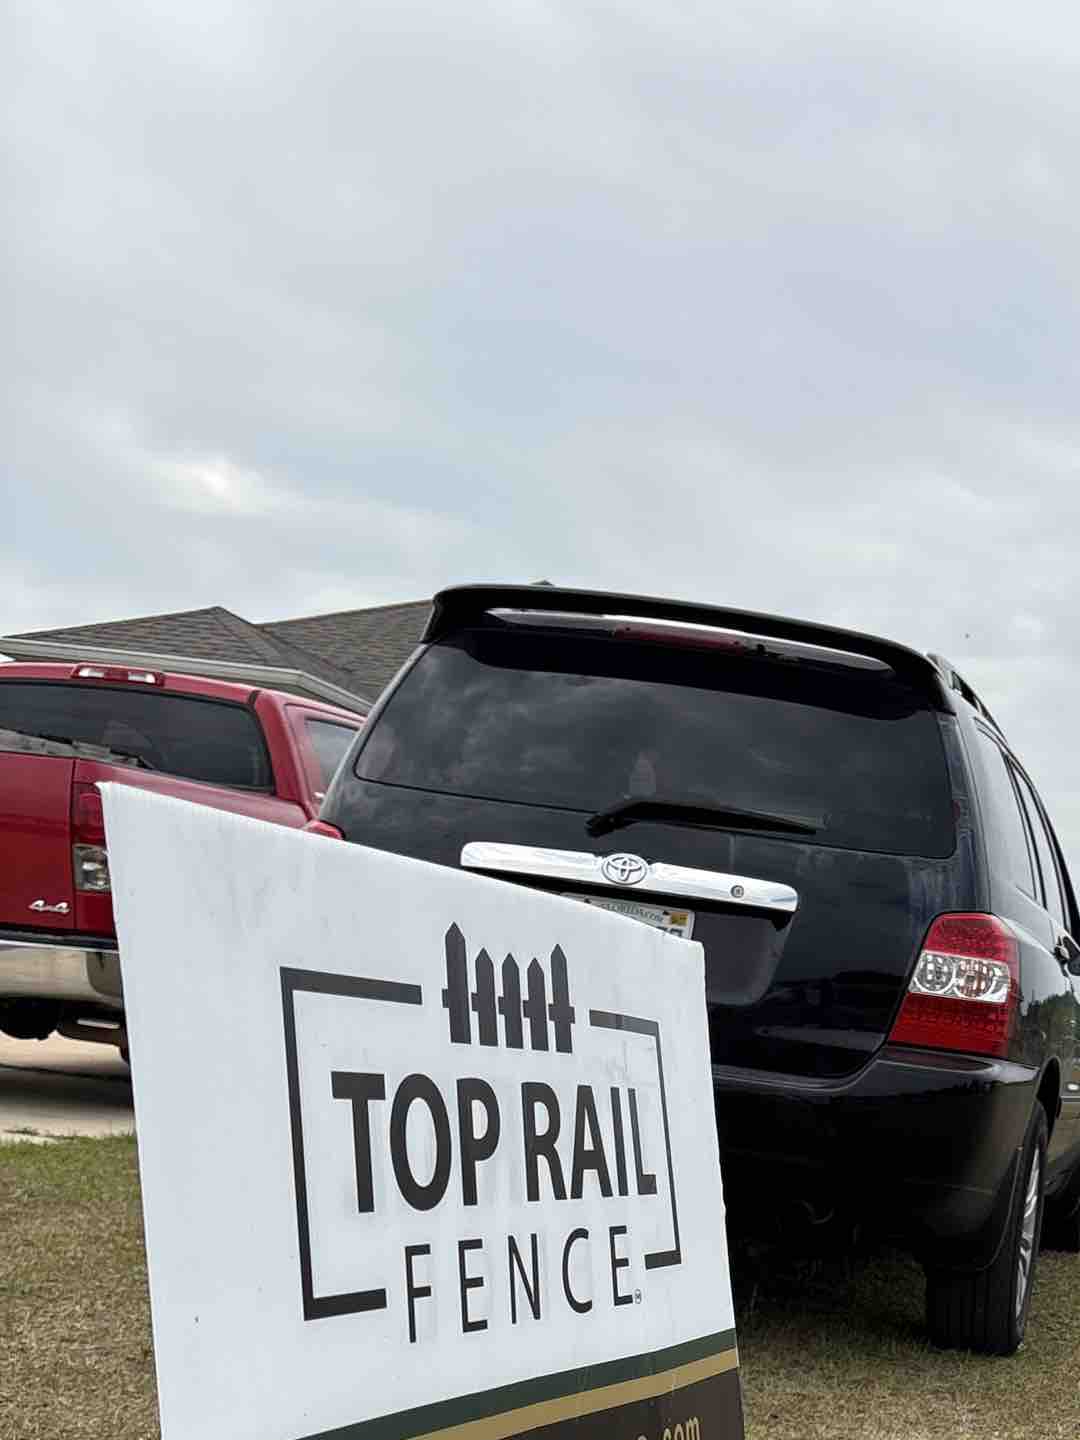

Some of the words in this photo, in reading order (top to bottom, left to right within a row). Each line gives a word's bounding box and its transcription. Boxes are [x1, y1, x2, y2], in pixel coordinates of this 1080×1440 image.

[331, 1071, 500, 1213] TOP
[521, 1081, 657, 1202] RAIL
[404, 1225, 634, 1343] FENCE
